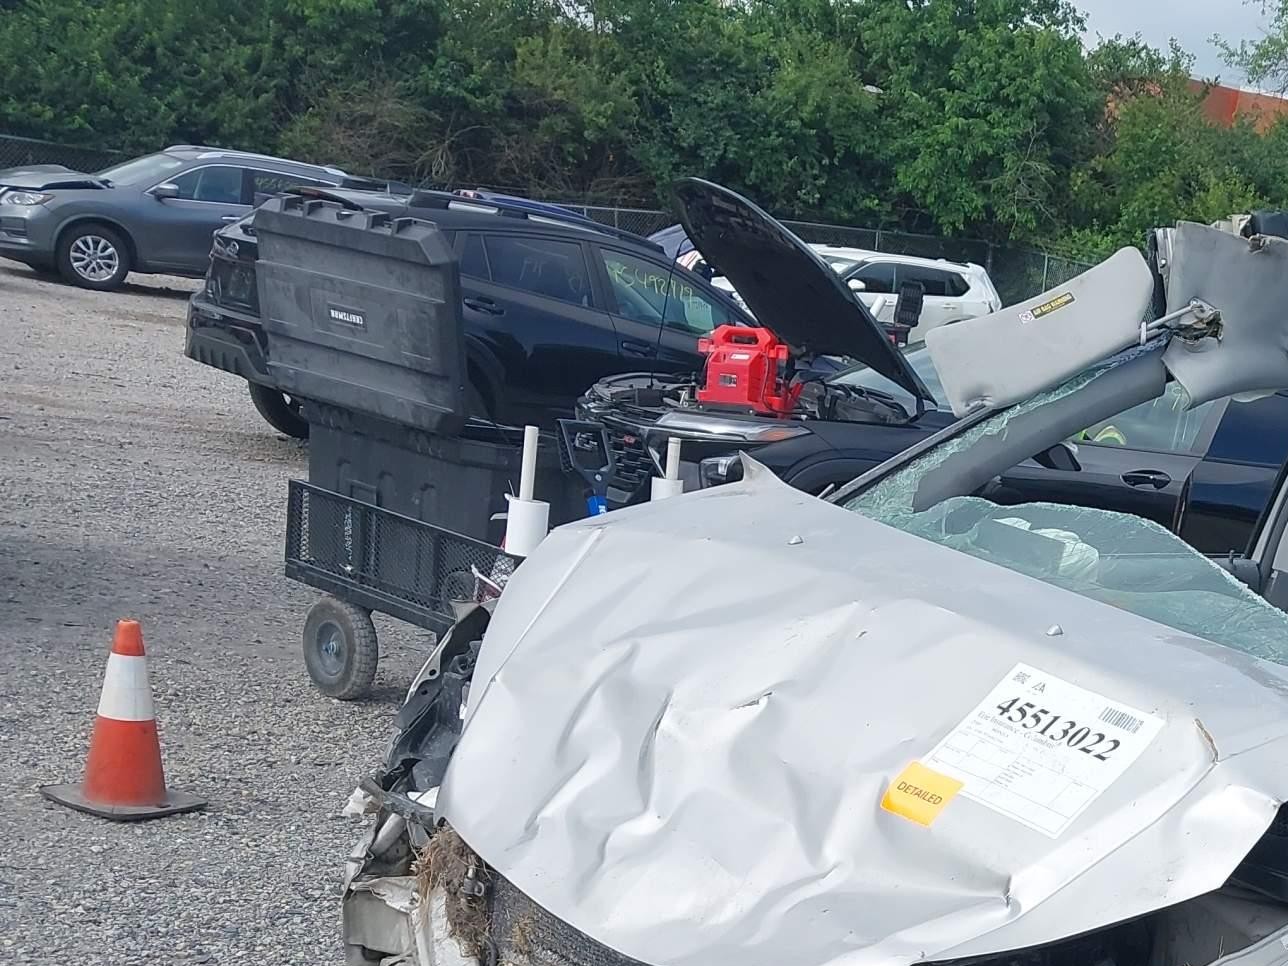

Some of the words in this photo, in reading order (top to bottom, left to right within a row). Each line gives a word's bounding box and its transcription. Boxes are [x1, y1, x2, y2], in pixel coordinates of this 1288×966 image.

[330, 309, 363, 325] CRAFTSMAN
[996, 697, 1121, 761] 45513022
[897, 780, 943, 806] DETAILED
